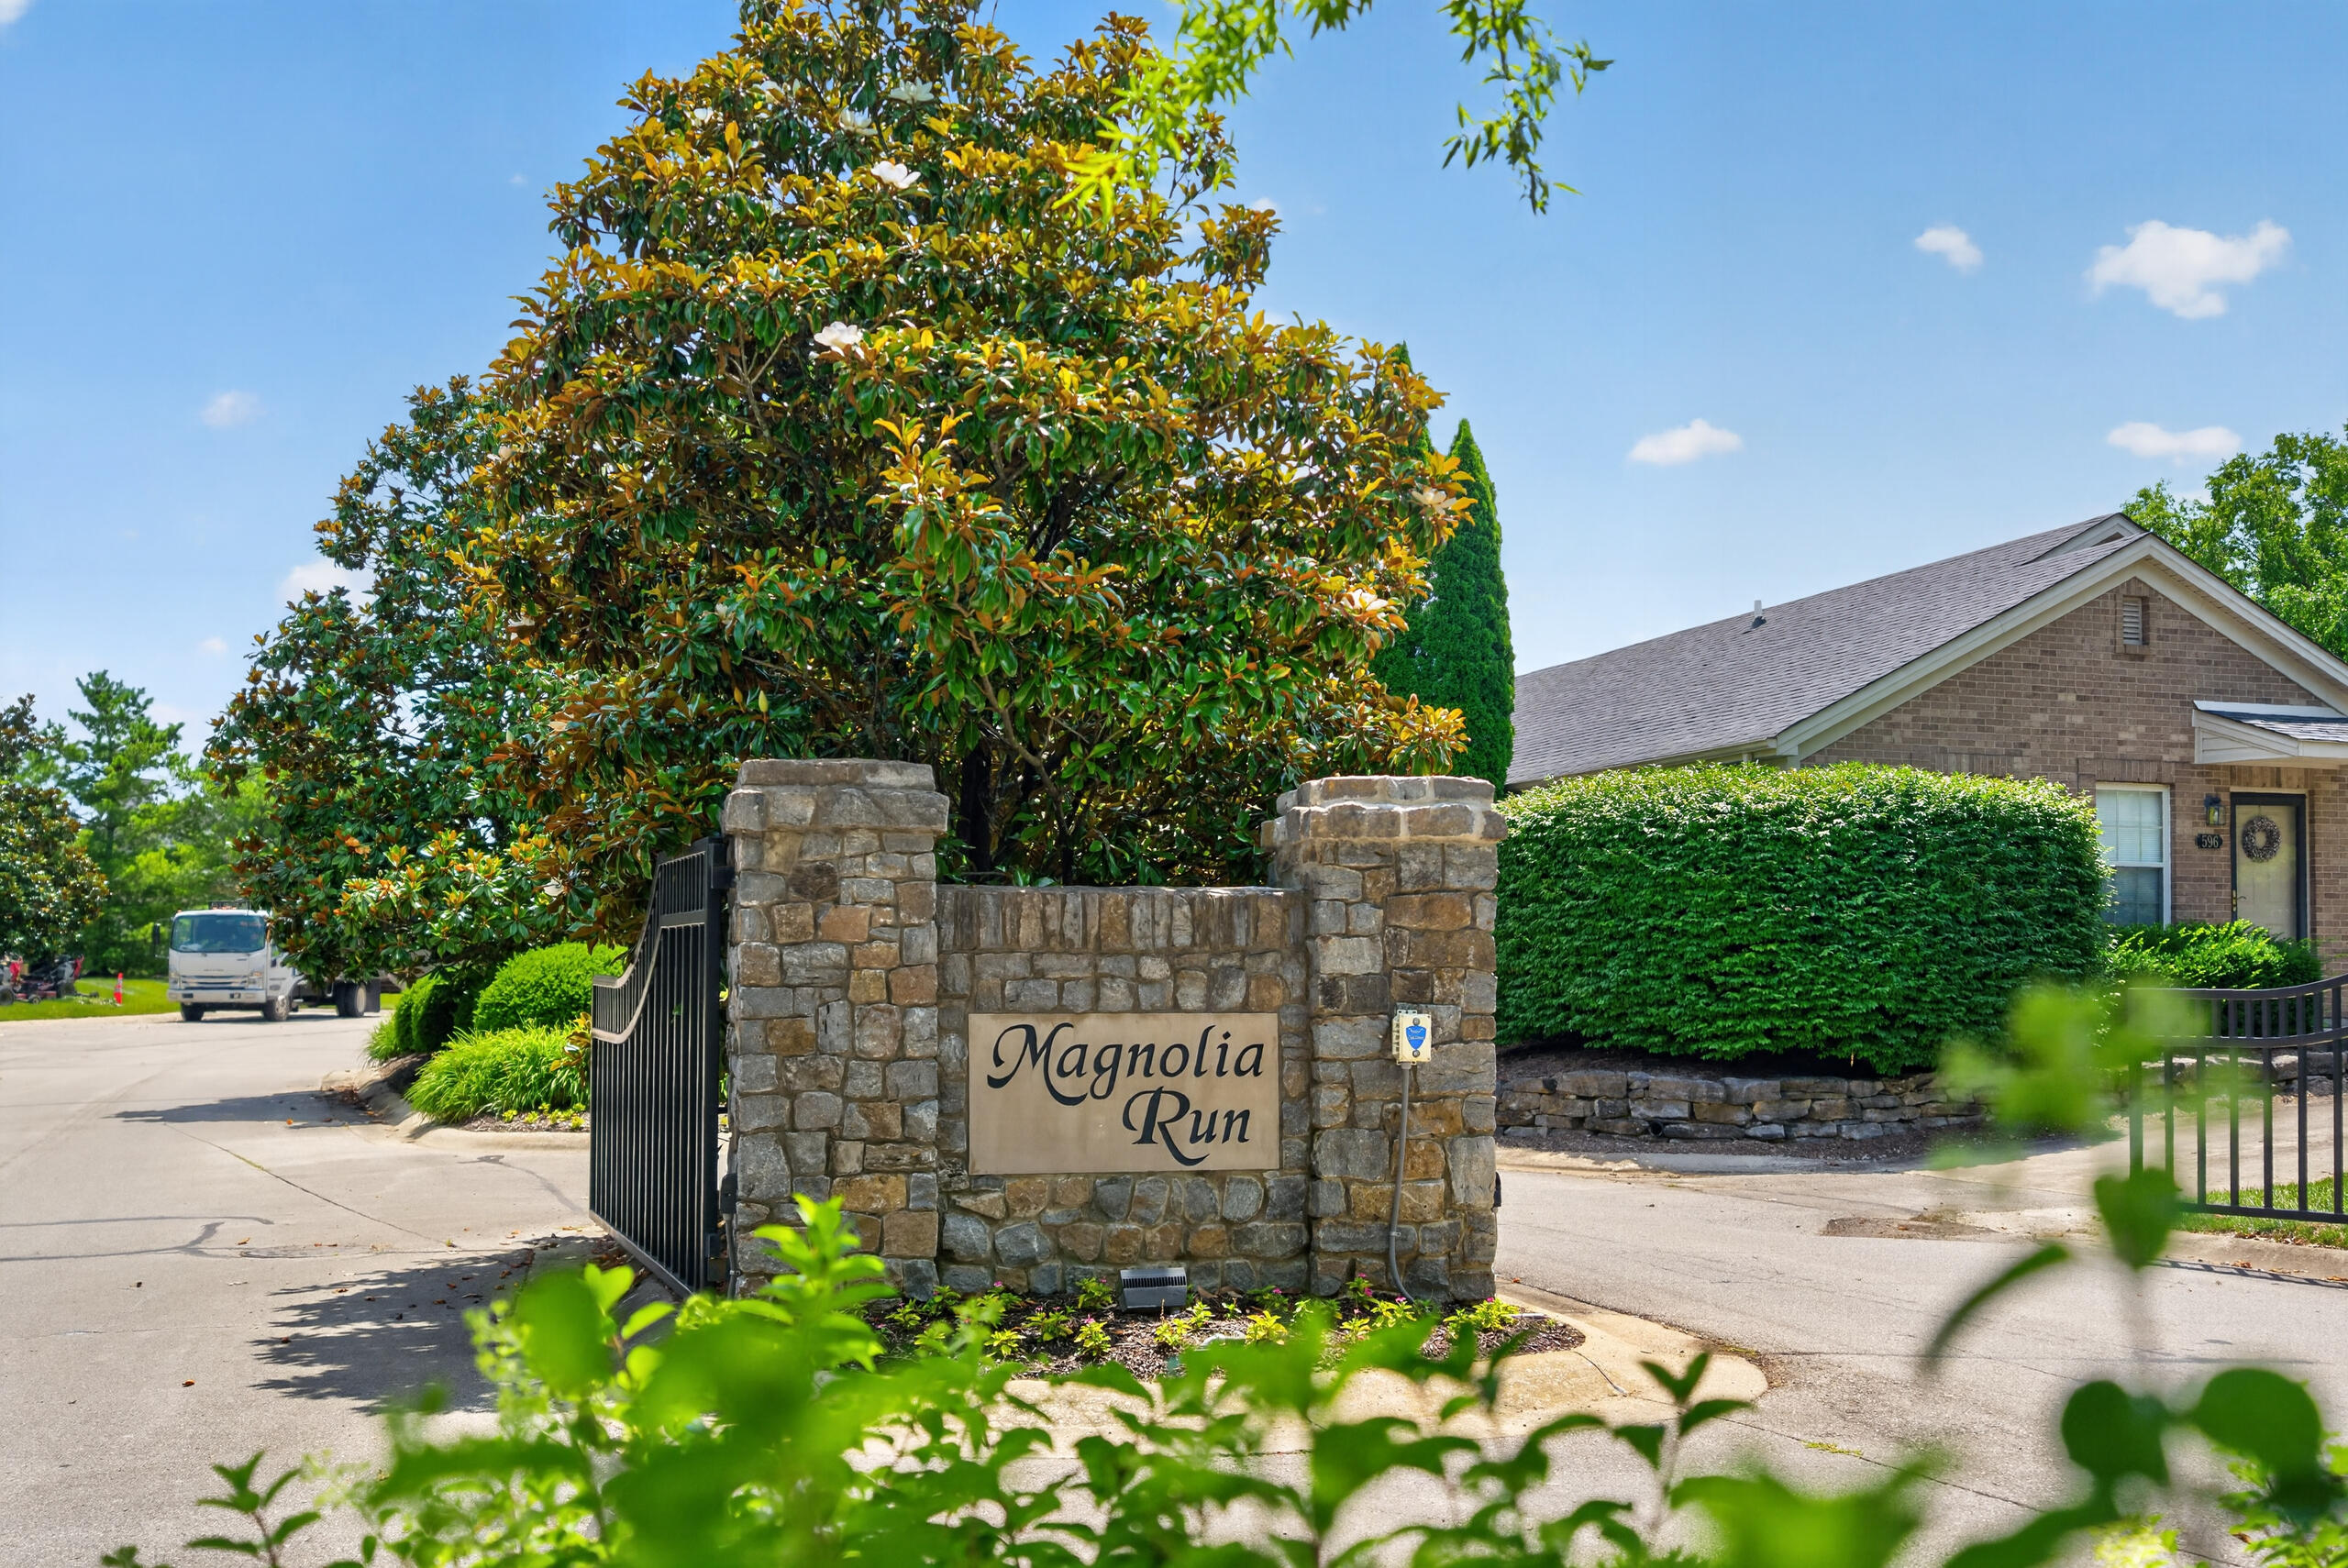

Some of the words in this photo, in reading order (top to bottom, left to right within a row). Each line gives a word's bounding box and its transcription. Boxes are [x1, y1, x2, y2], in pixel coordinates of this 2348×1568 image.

[2201, 834, 2219, 848] 596
[987, 1022, 1265, 1106] Magnolia
[1122, 1086, 1251, 1166] Run
